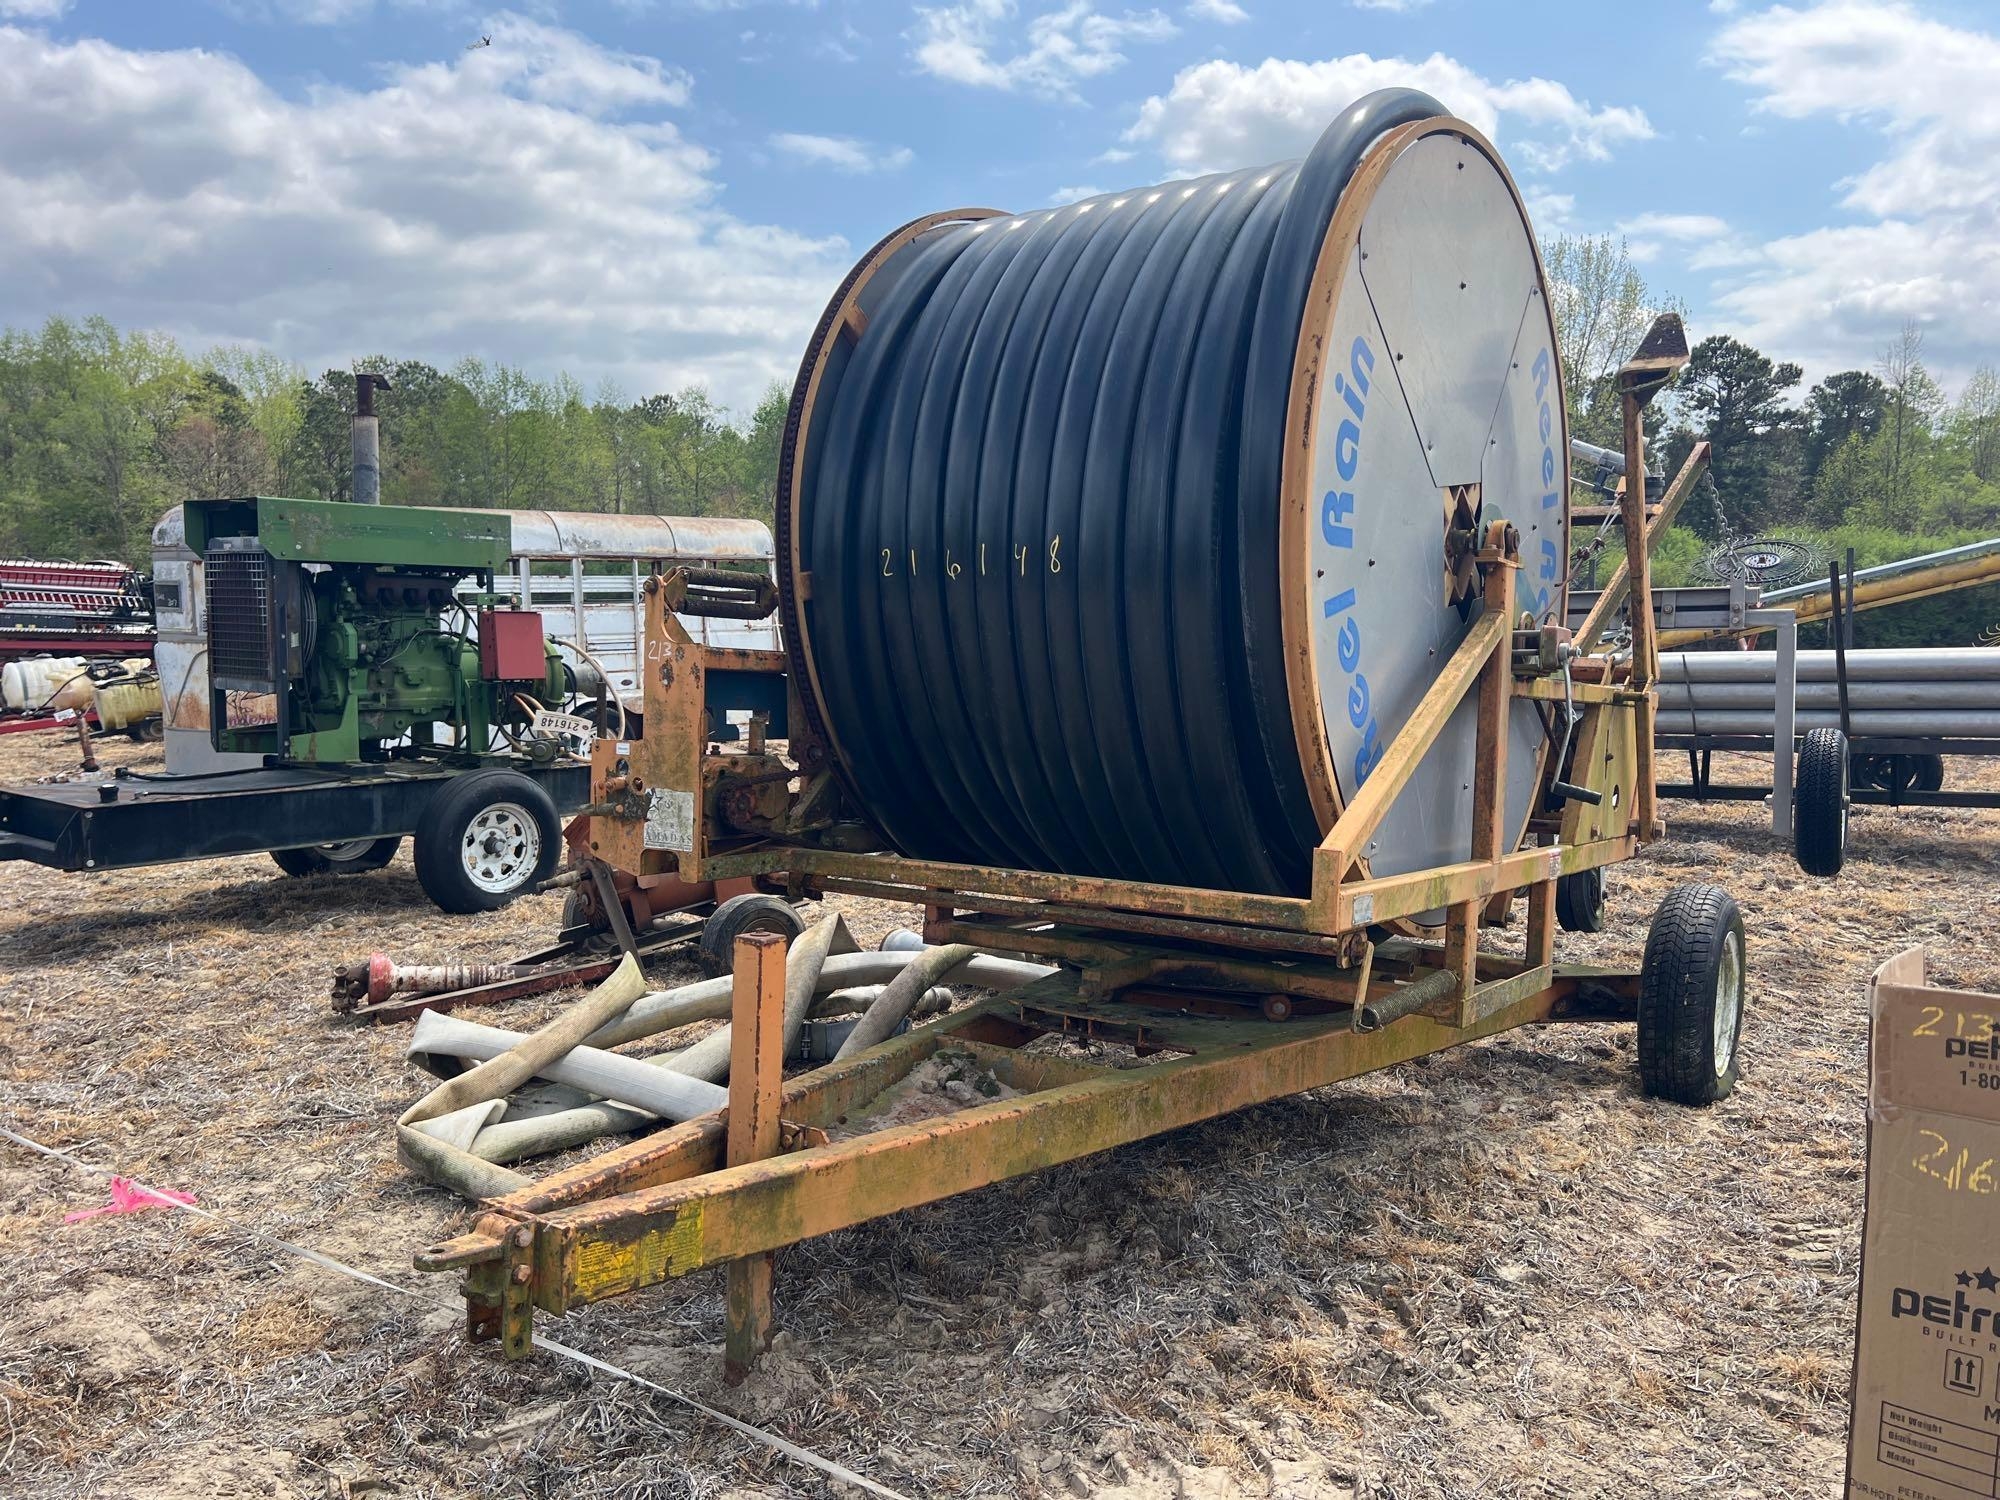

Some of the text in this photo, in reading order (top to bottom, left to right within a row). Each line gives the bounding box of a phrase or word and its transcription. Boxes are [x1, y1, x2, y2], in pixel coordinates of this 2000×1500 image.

[1532, 347, 1559, 510] Reel
[881, 534, 1062, 581] 216148
[1321, 335, 1384, 789] Reel Rain
[647, 640, 673, 662] 213
[541, 717, 580, 732] 216148
[644, 831, 692, 844] AMADAS
[1912, 1129, 1998, 1194] 216
[1922, 1326, 1977, 1347] BUILT
[1908, 1416, 1943, 1434] Weight
[1886, 1450, 1915, 1467] Model
